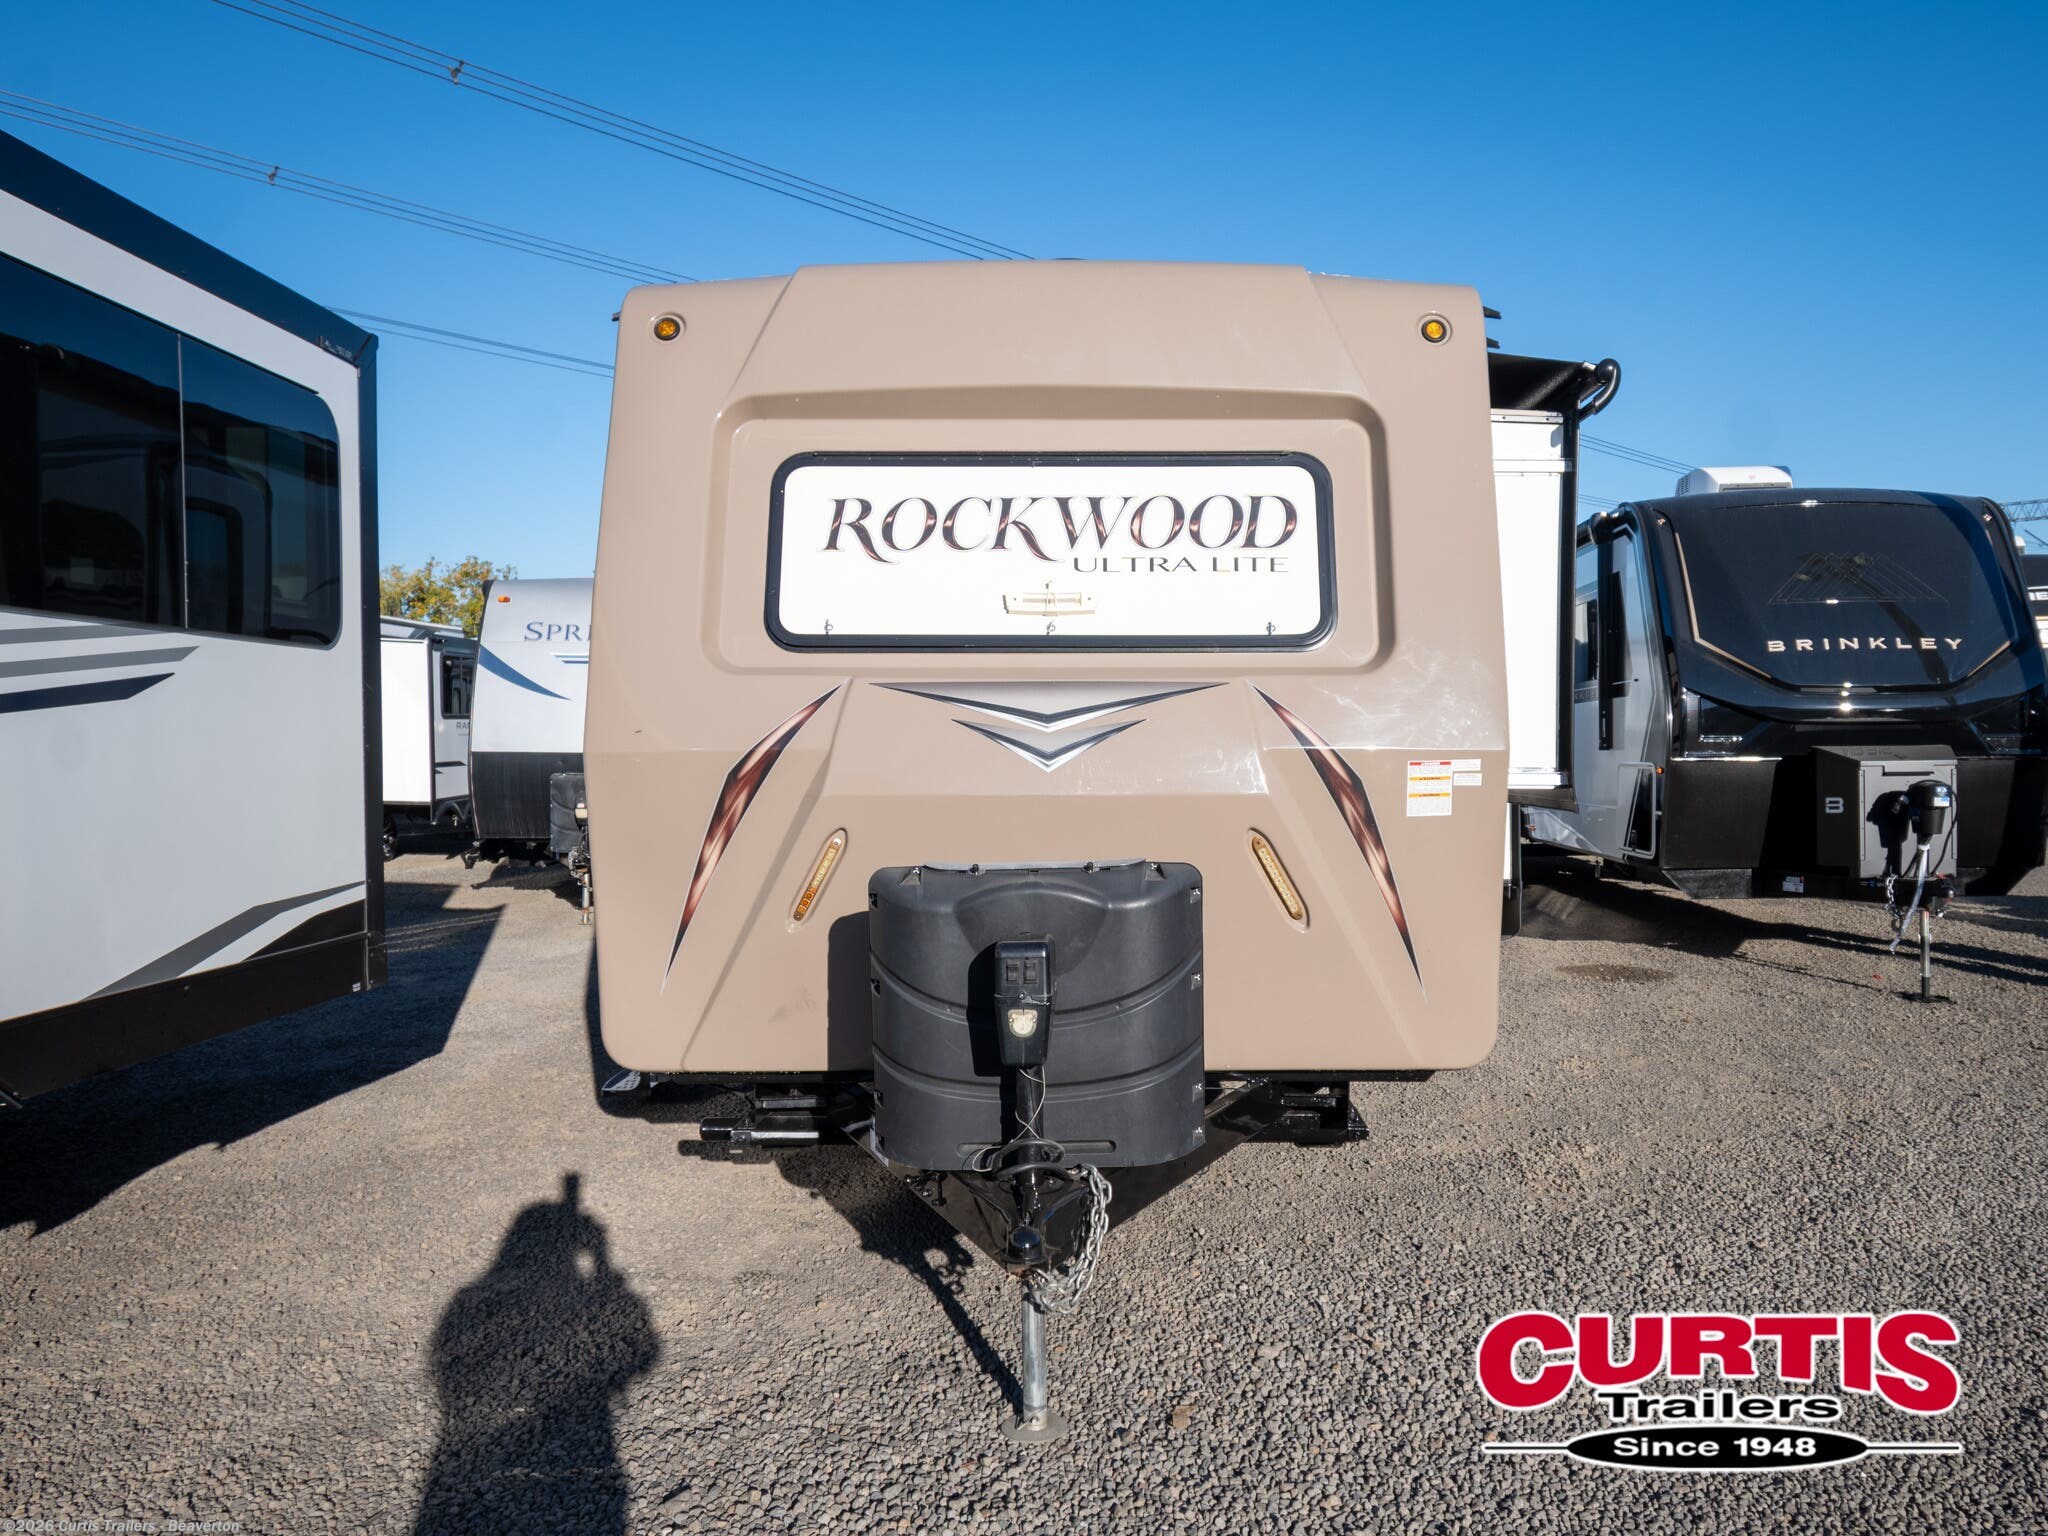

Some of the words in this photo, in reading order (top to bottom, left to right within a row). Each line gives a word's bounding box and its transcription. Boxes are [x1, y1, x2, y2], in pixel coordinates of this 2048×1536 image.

[819, 494, 1298, 564] ROCKWOOD
[1072, 556, 1197, 573] ULTRA
[1211, 556, 1289, 573] LITE
[1767, 637, 1962, 652] BRINKLEY
